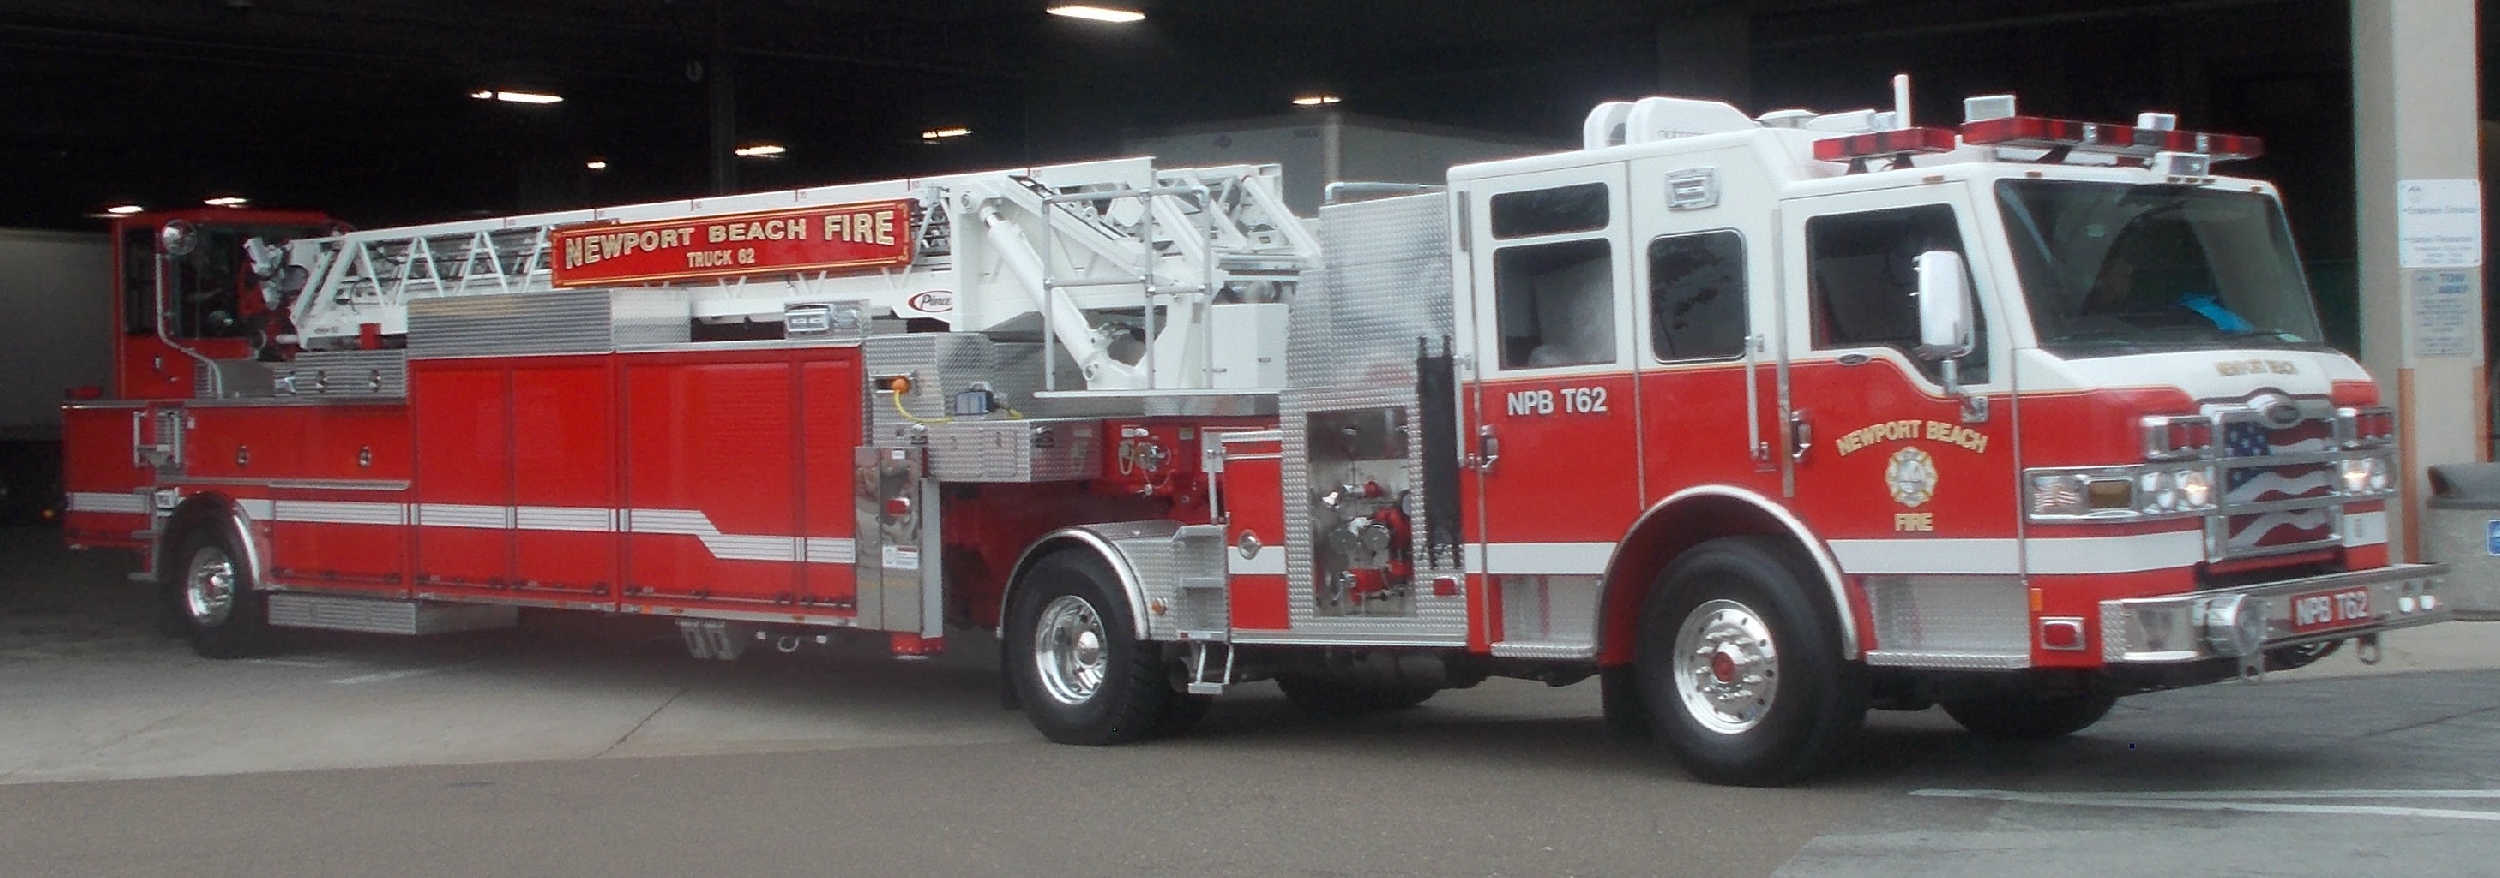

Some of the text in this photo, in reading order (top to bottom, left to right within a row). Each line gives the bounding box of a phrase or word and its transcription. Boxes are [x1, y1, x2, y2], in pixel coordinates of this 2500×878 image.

[564, 210, 895, 270] NEWPORT BEACH FIRE
[687, 248, 755, 268] TRUCK 62
[920, 293, 952, 310] Pierc
[1507, 386, 1608, 416] NPB T62
[1836, 419, 1989, 457] NEWPORT BEACH
[1894, 512, 1934, 532] FIRE
[2295, 590, 2368, 626] NPB T62
